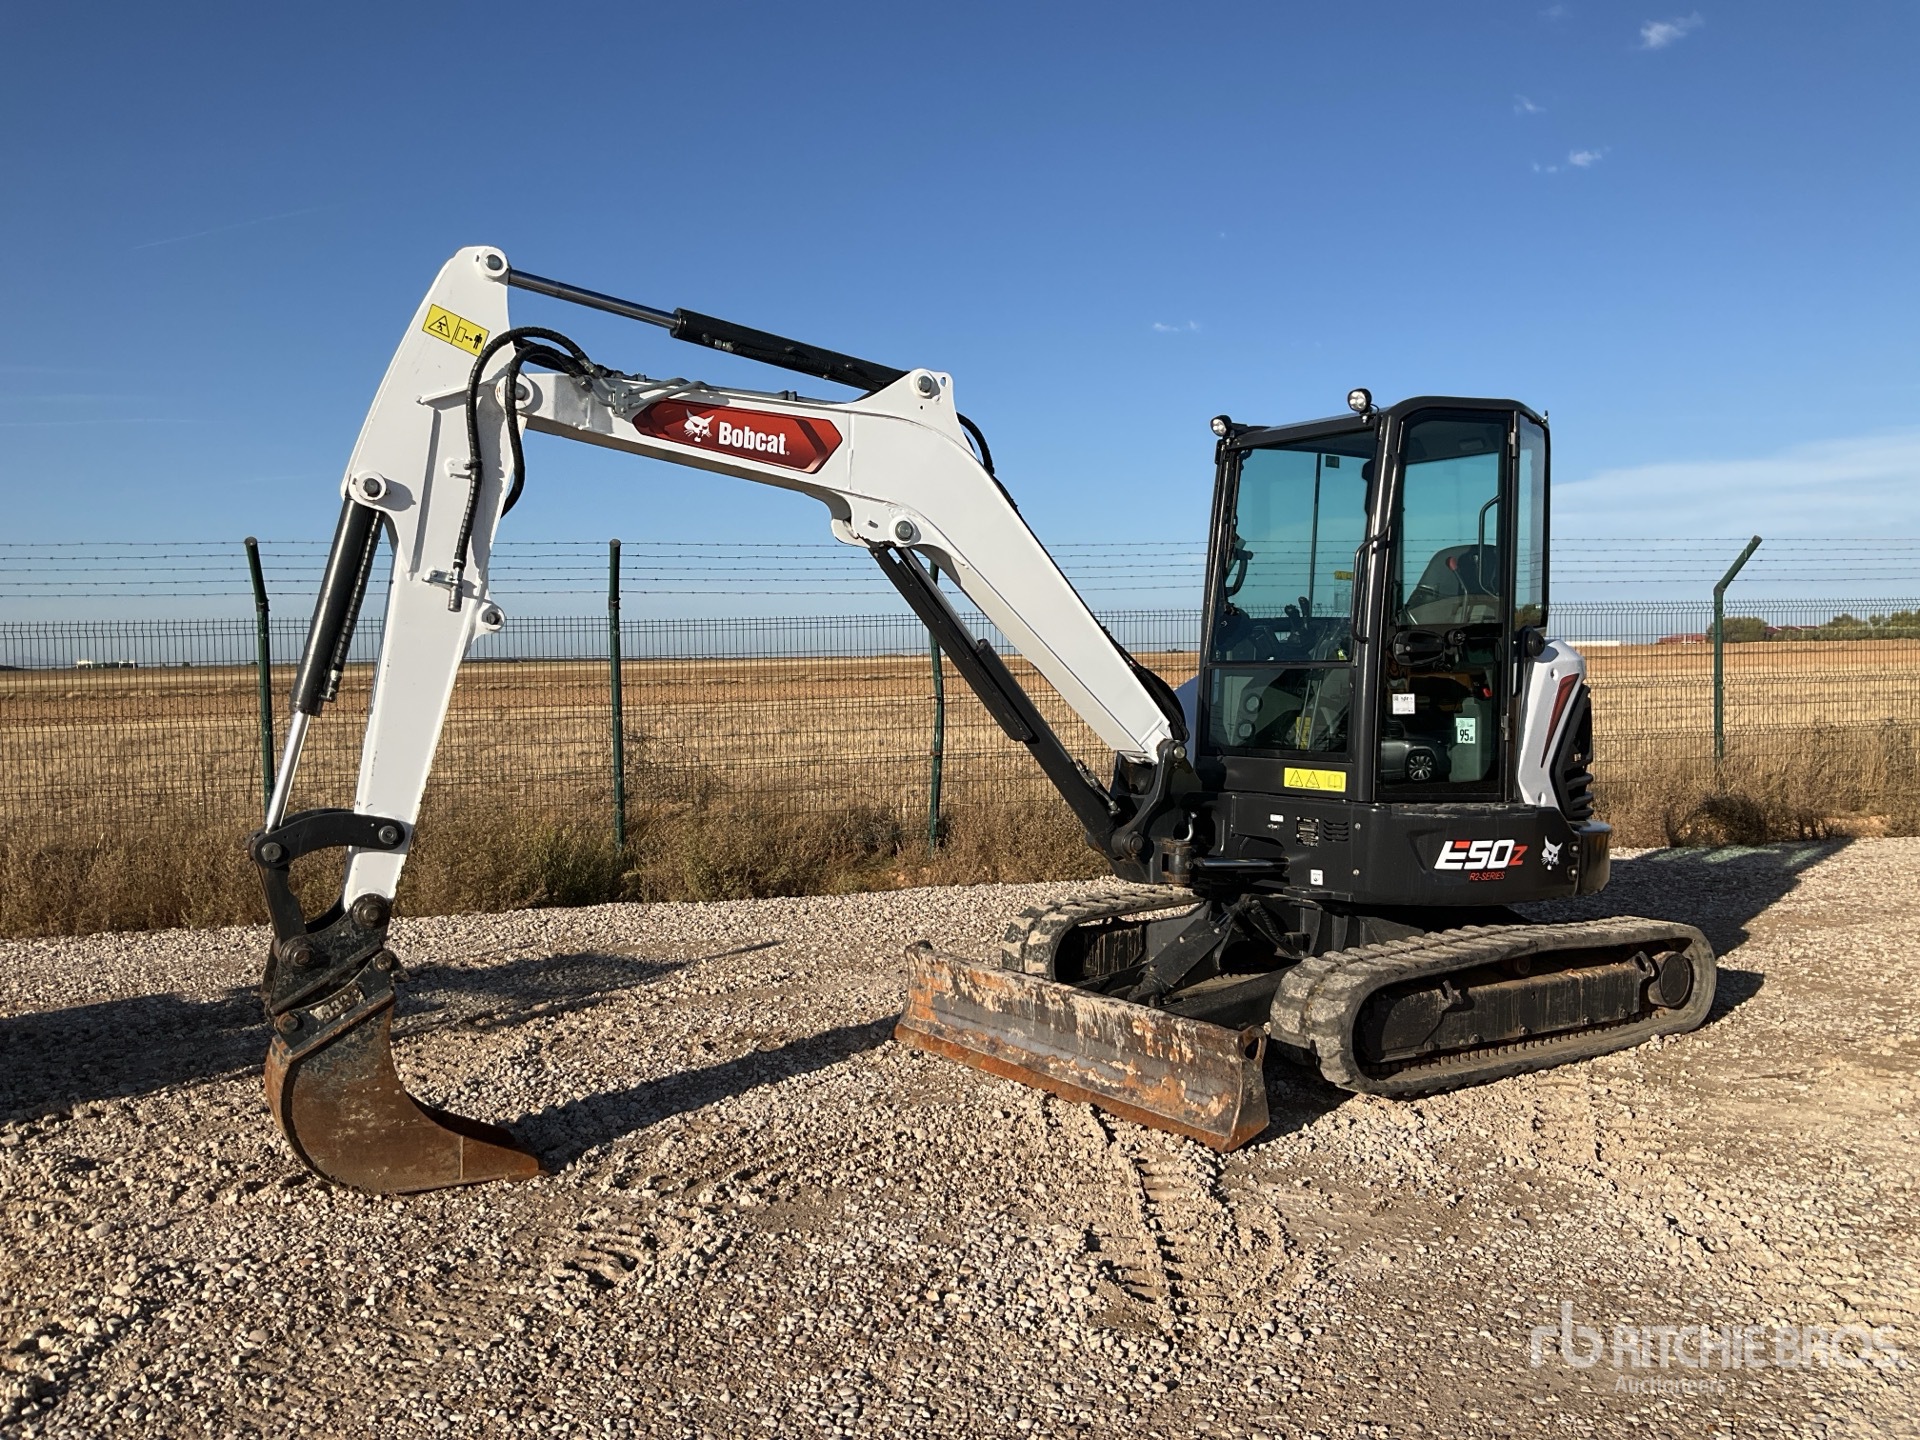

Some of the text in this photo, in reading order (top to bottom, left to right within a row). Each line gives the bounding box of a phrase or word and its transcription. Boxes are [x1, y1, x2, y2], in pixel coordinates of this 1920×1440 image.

[718, 421, 787, 455] Bobcat
[1460, 729, 1470, 742] 95
[1469, 871, 1506, 881] R2-SERIES
